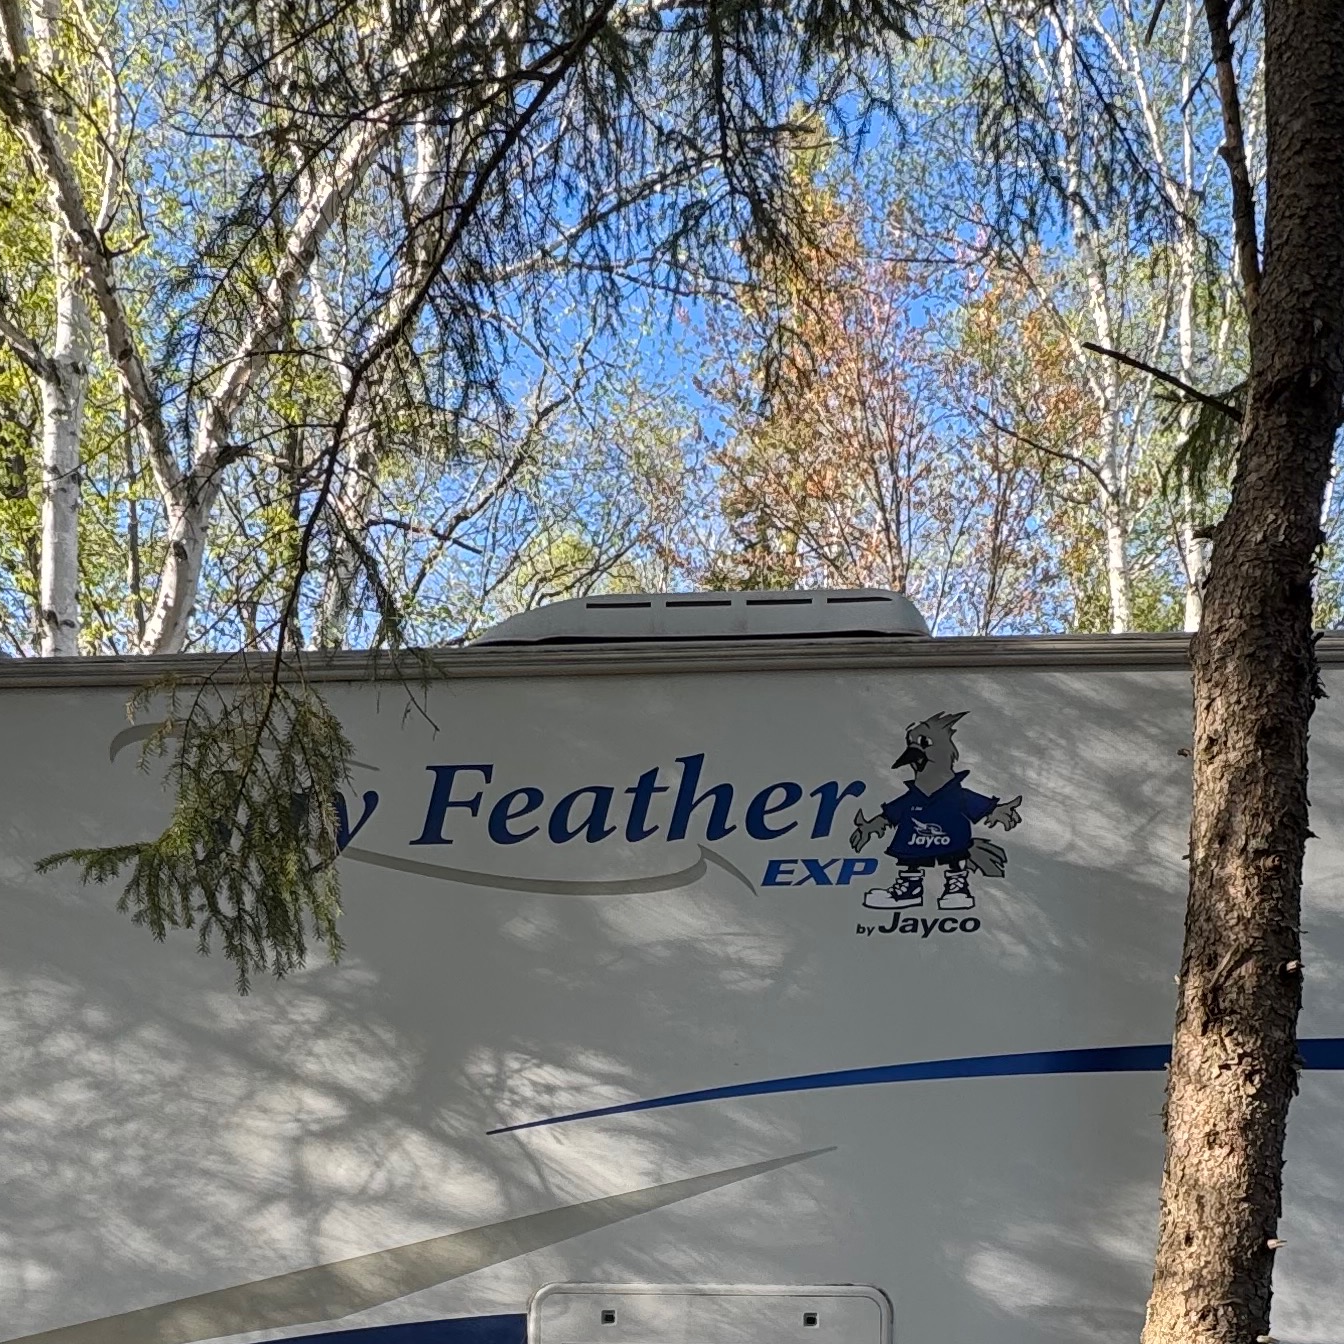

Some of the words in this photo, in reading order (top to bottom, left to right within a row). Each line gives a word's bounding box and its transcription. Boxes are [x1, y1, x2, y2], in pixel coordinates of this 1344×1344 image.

[408, 752, 867, 846] Feather
[907, 833, 951, 848] Jayco
[760, 857, 878, 887] EXP
[856, 923, 875, 937] by
[878, 911, 981, 939] Jayco
